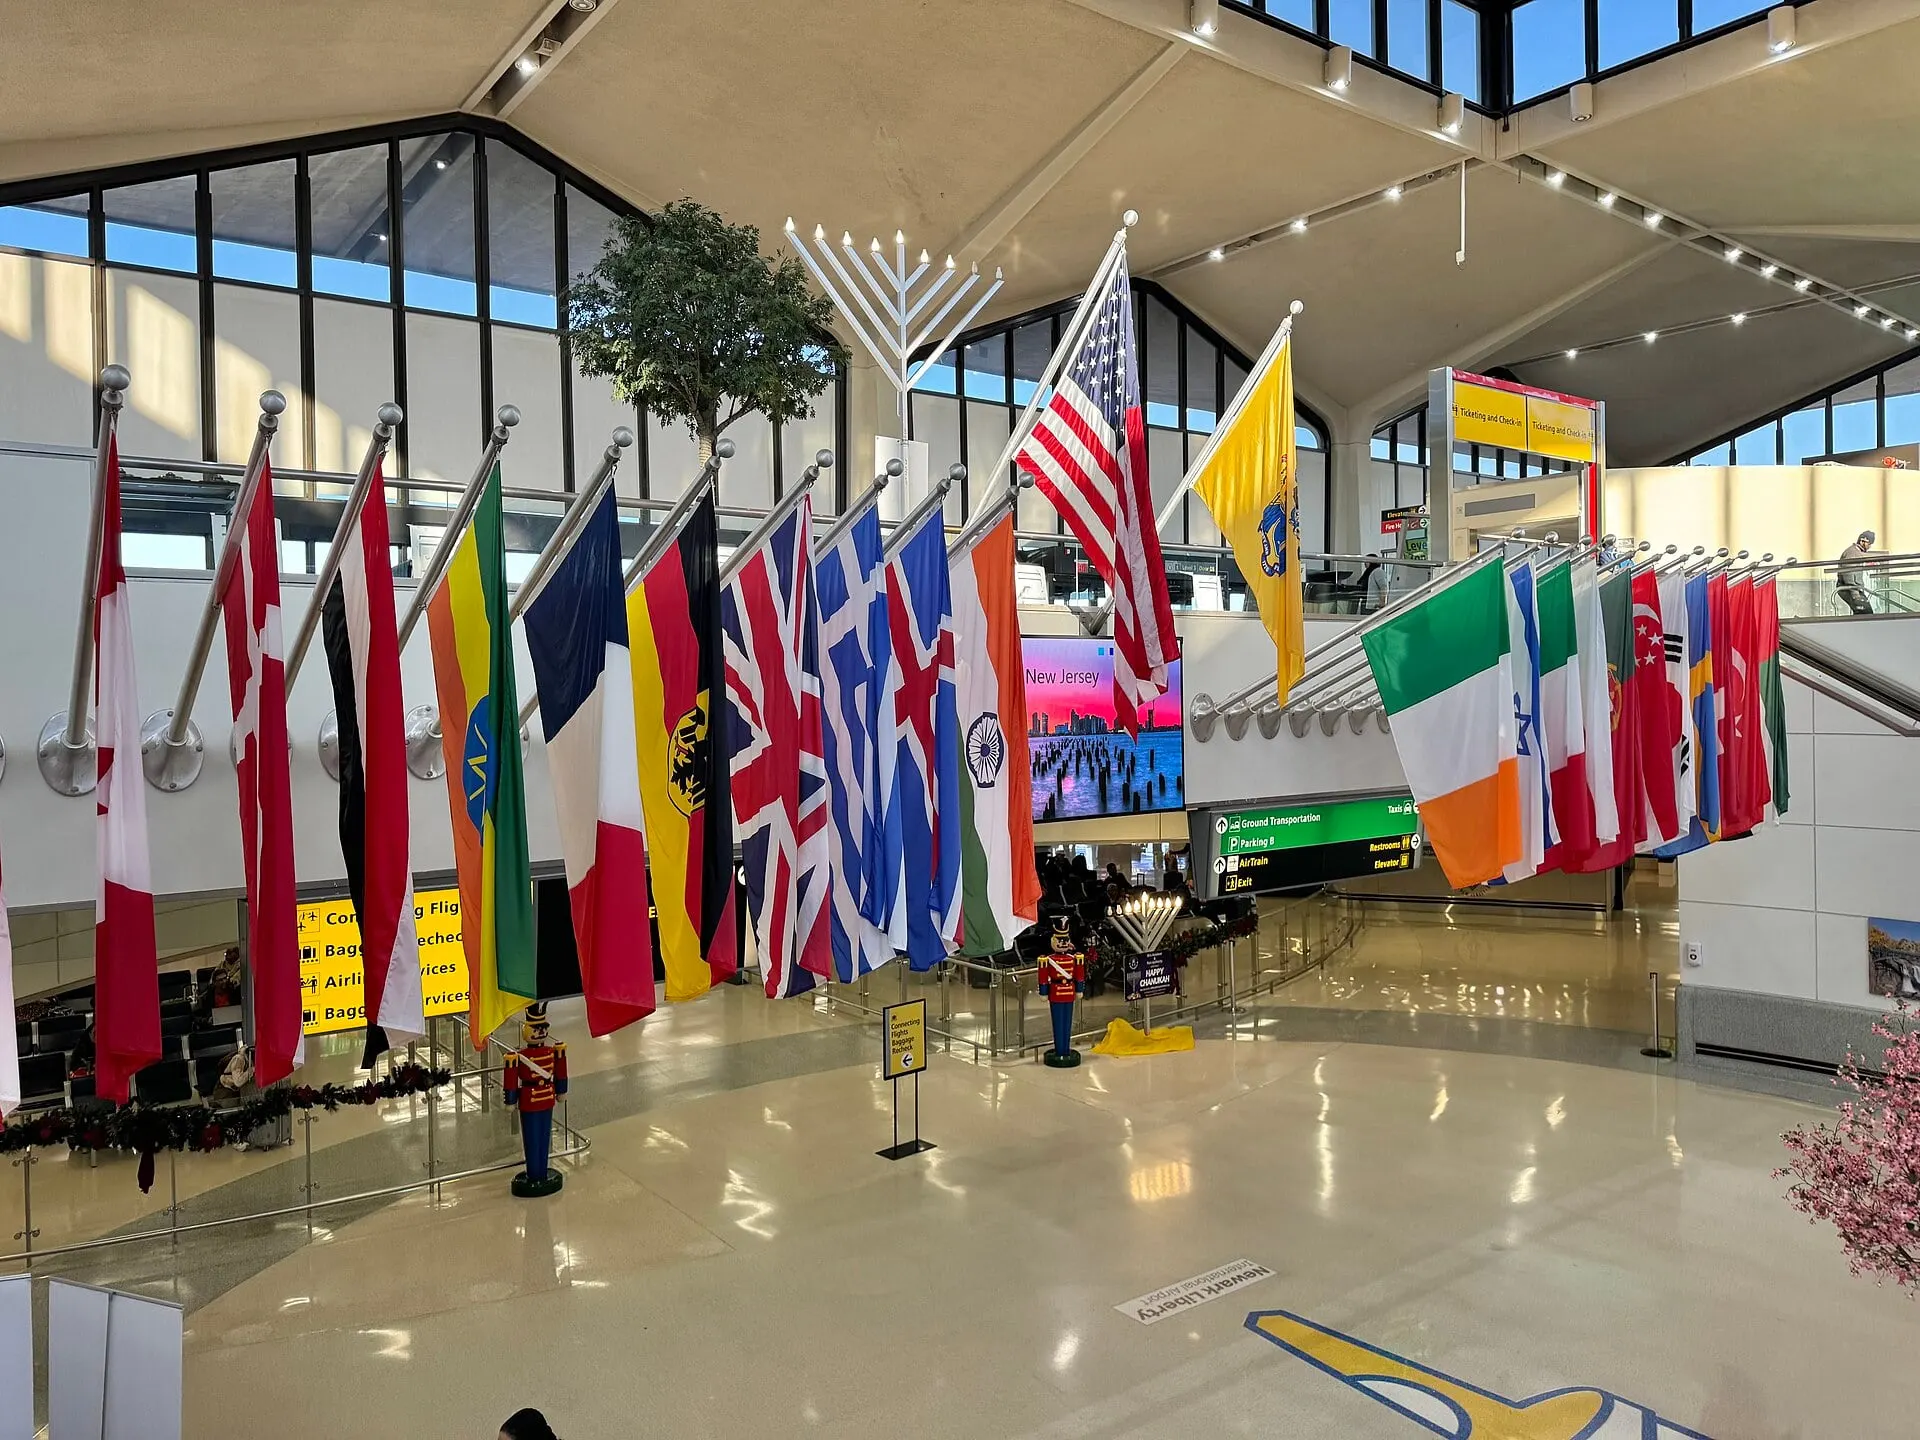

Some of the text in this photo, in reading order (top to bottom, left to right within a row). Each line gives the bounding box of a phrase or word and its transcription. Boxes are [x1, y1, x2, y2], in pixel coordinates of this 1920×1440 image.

[1460, 407, 1522, 427] Ticketing and Check-in
[1532, 420, 1555, 435] Ticketing
[1556, 426, 1566, 435] and
[1025, 668, 1100, 688] New Jersey
[1387, 804, 1403, 814] Taxis
[1241, 812, 1321, 829] Ground Transportation
[1240, 838, 1268, 849] Parking
[1269, 836, 1275, 846] B
[1369, 841, 1401, 852] Restrooms
[1239, 856, 1269, 869] AirTrain
[1374, 857, 1400, 869] Elevator
[1237, 877, 1253, 888] Exit
[430, 900, 459, 916] Flig
[1145, 967, 1164, 977] HAPPY
[324, 972, 361, 989] Airli
[1140, 975, 1170, 987] CHANUKAH
[891, 1019, 920, 1029] Connecting
[891, 1030, 908, 1038] Flights
[892, 1037, 914, 1046] Baggage
[892, 1046, 913, 1054] Recheck
[1137, 1266, 1270, 1321] Newark Liberty
[1141, 1287, 1181, 1306] Airport
